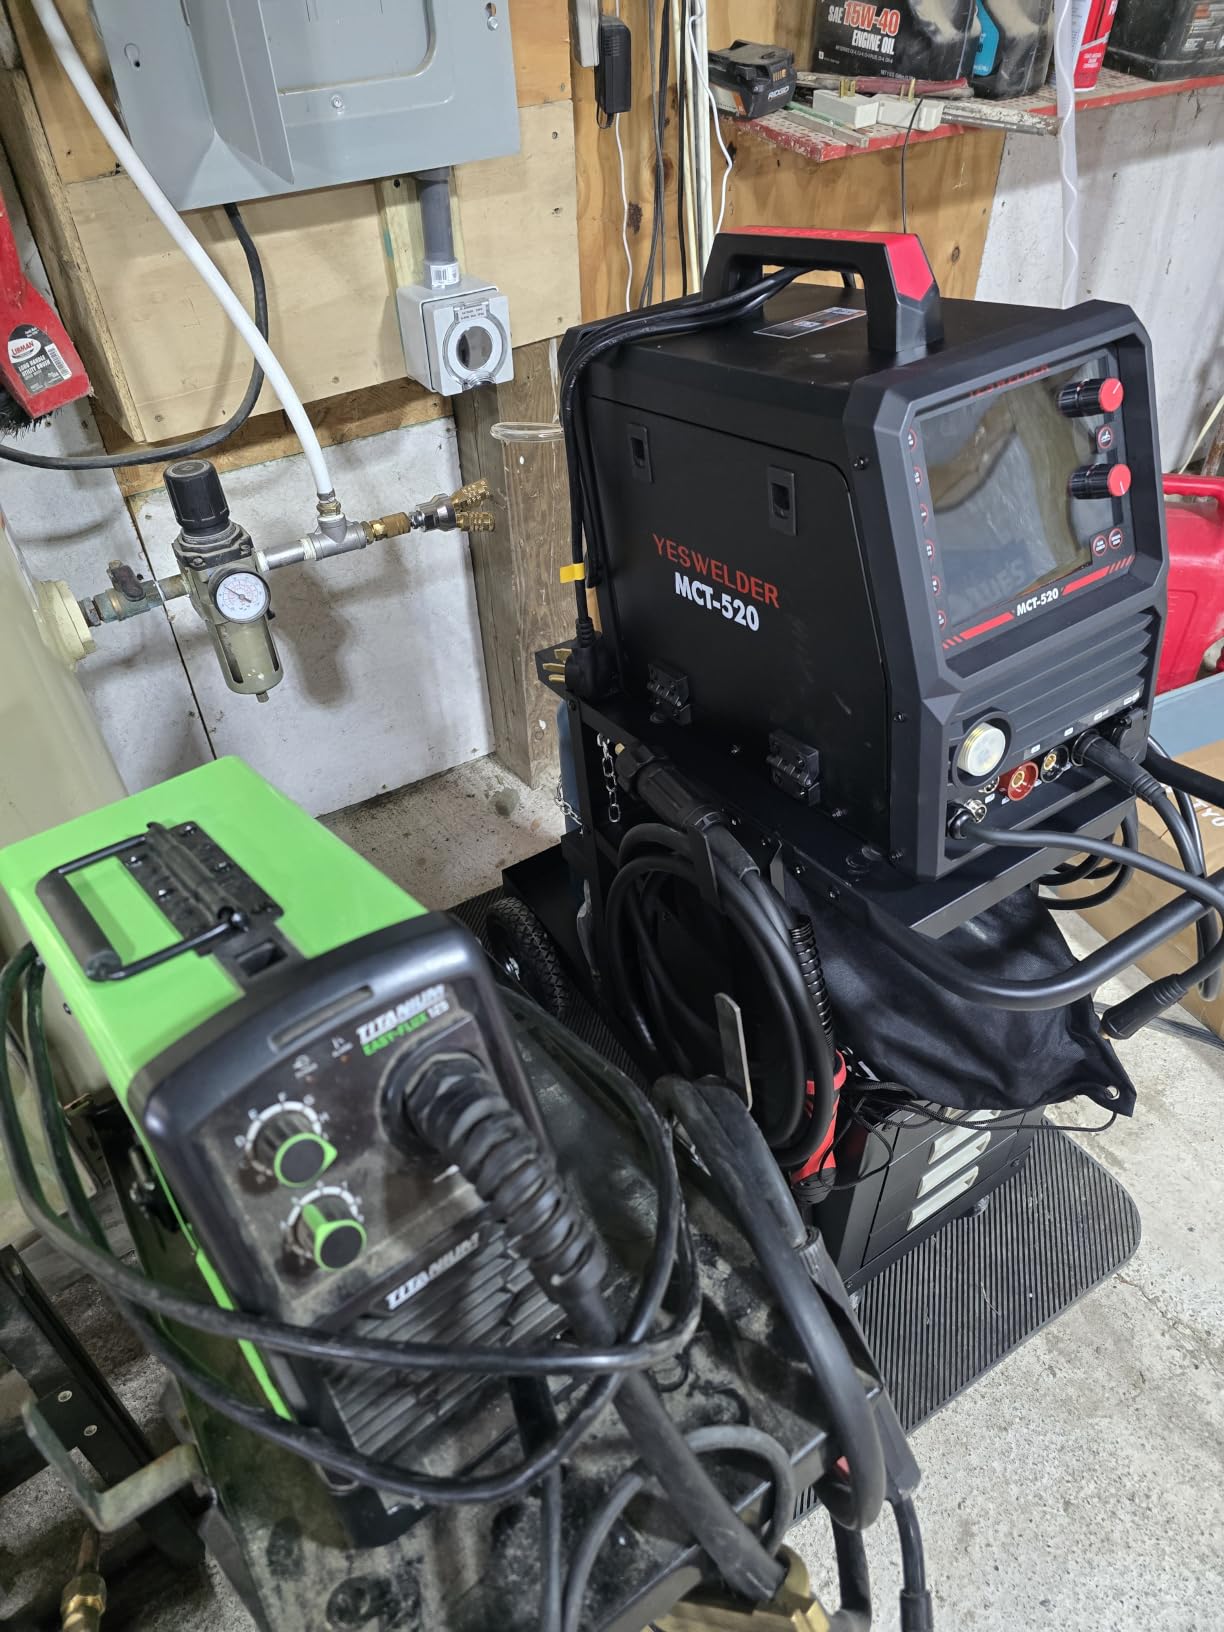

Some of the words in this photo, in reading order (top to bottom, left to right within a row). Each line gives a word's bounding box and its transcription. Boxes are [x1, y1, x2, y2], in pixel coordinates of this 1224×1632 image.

[828, 5, 844, 24] SAE
[843, 1, 901, 36] 15W-40
[851, 29, 882, 52] ENGINE
[881, 36, 896, 55] OIL
[11, 340, 34, 356] LIBMAN
[653, 533, 780, 609] YESWELDER
[674, 571, 760, 632] MCT-520
[1016, 587, 1060, 617] MCT-520
[356, 984, 445, 1045] TITANIUM
[385, 1231, 479, 1311] TITANIUM
